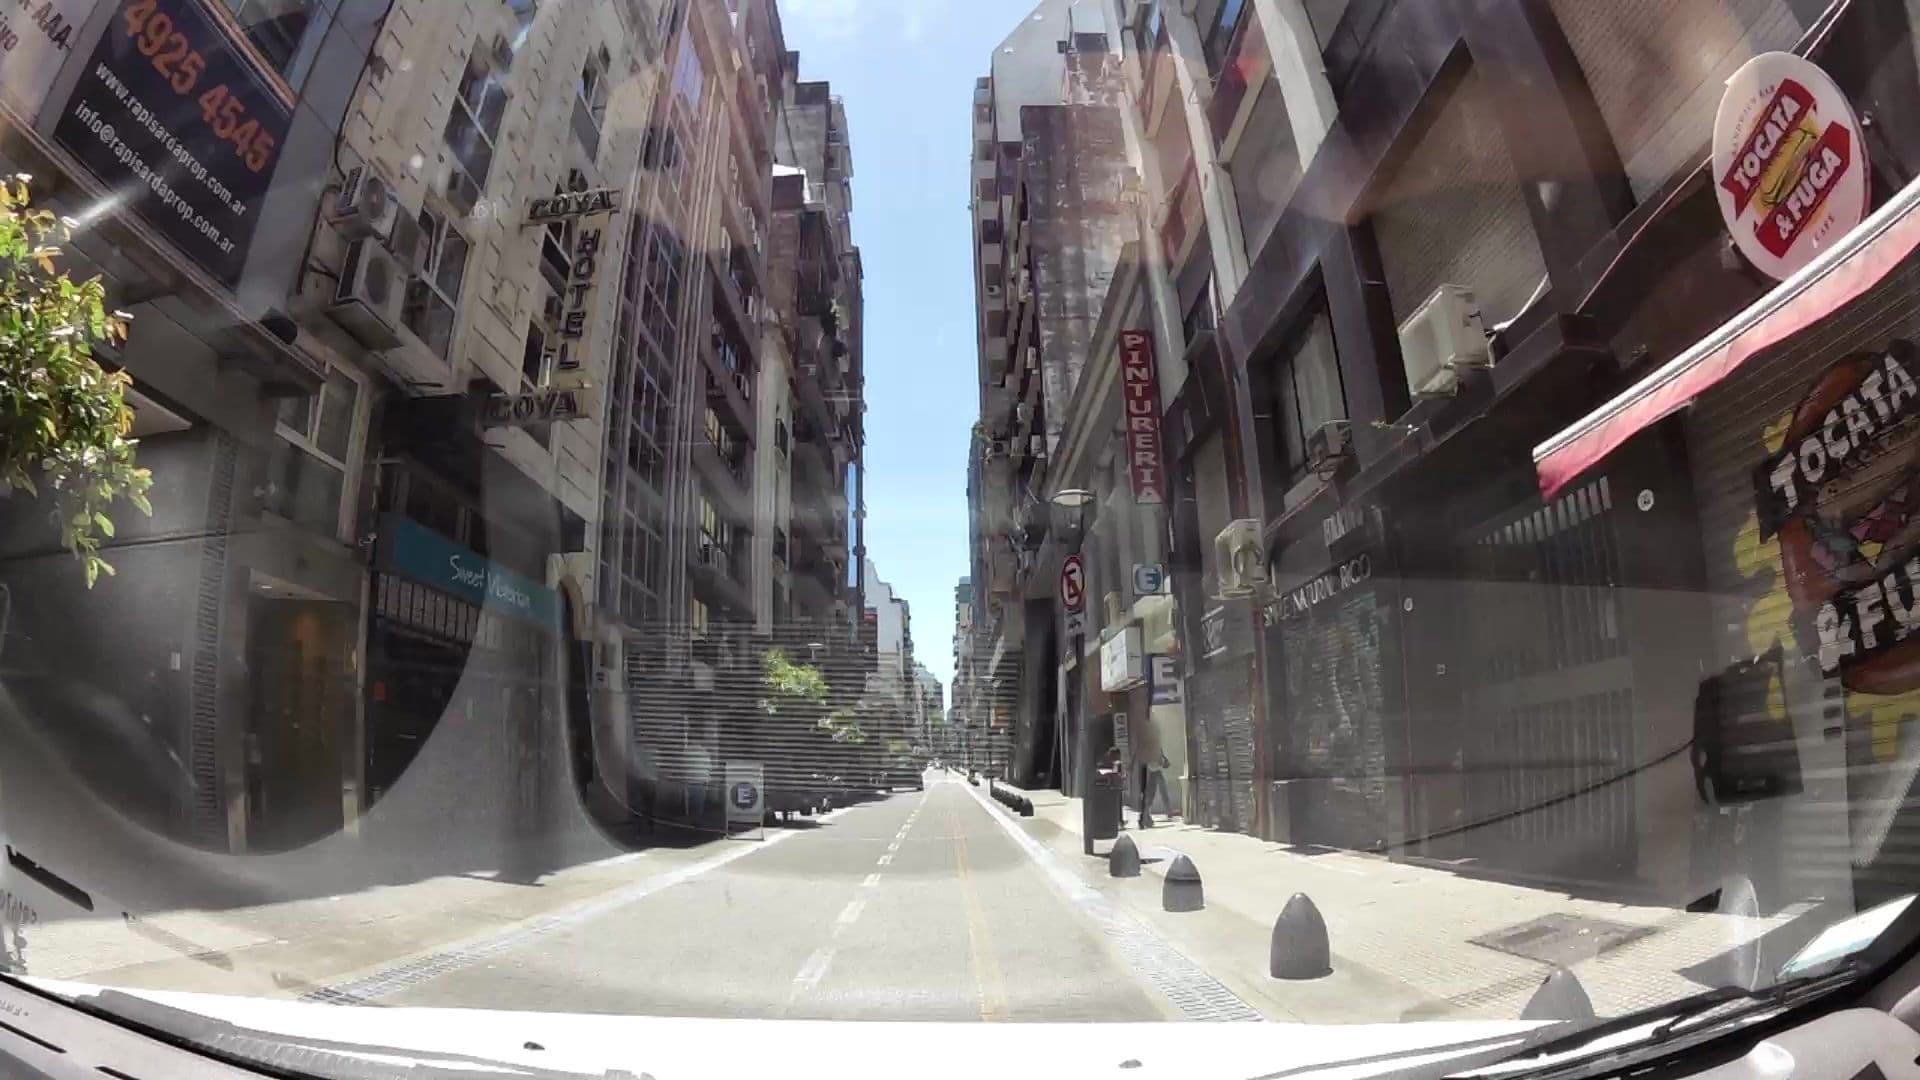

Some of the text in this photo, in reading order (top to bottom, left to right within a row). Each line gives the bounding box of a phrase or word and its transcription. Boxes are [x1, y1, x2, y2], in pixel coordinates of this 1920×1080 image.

[95, 62, 246, 216] www.rapisardaprop.com.ar
[123, 0, 274, 173] 4925 4545
[1733, 95, 1801, 190] TOCATA
[74, 100, 235, 255] info@rapisardaprop.com.ar
[1787, 147, 1842, 221] FUGA
[559, 228, 601, 370] HOTEL
[1122, 333, 1163, 504] PINTURERIA
[1770, 354, 1918, 509] TOCATA
